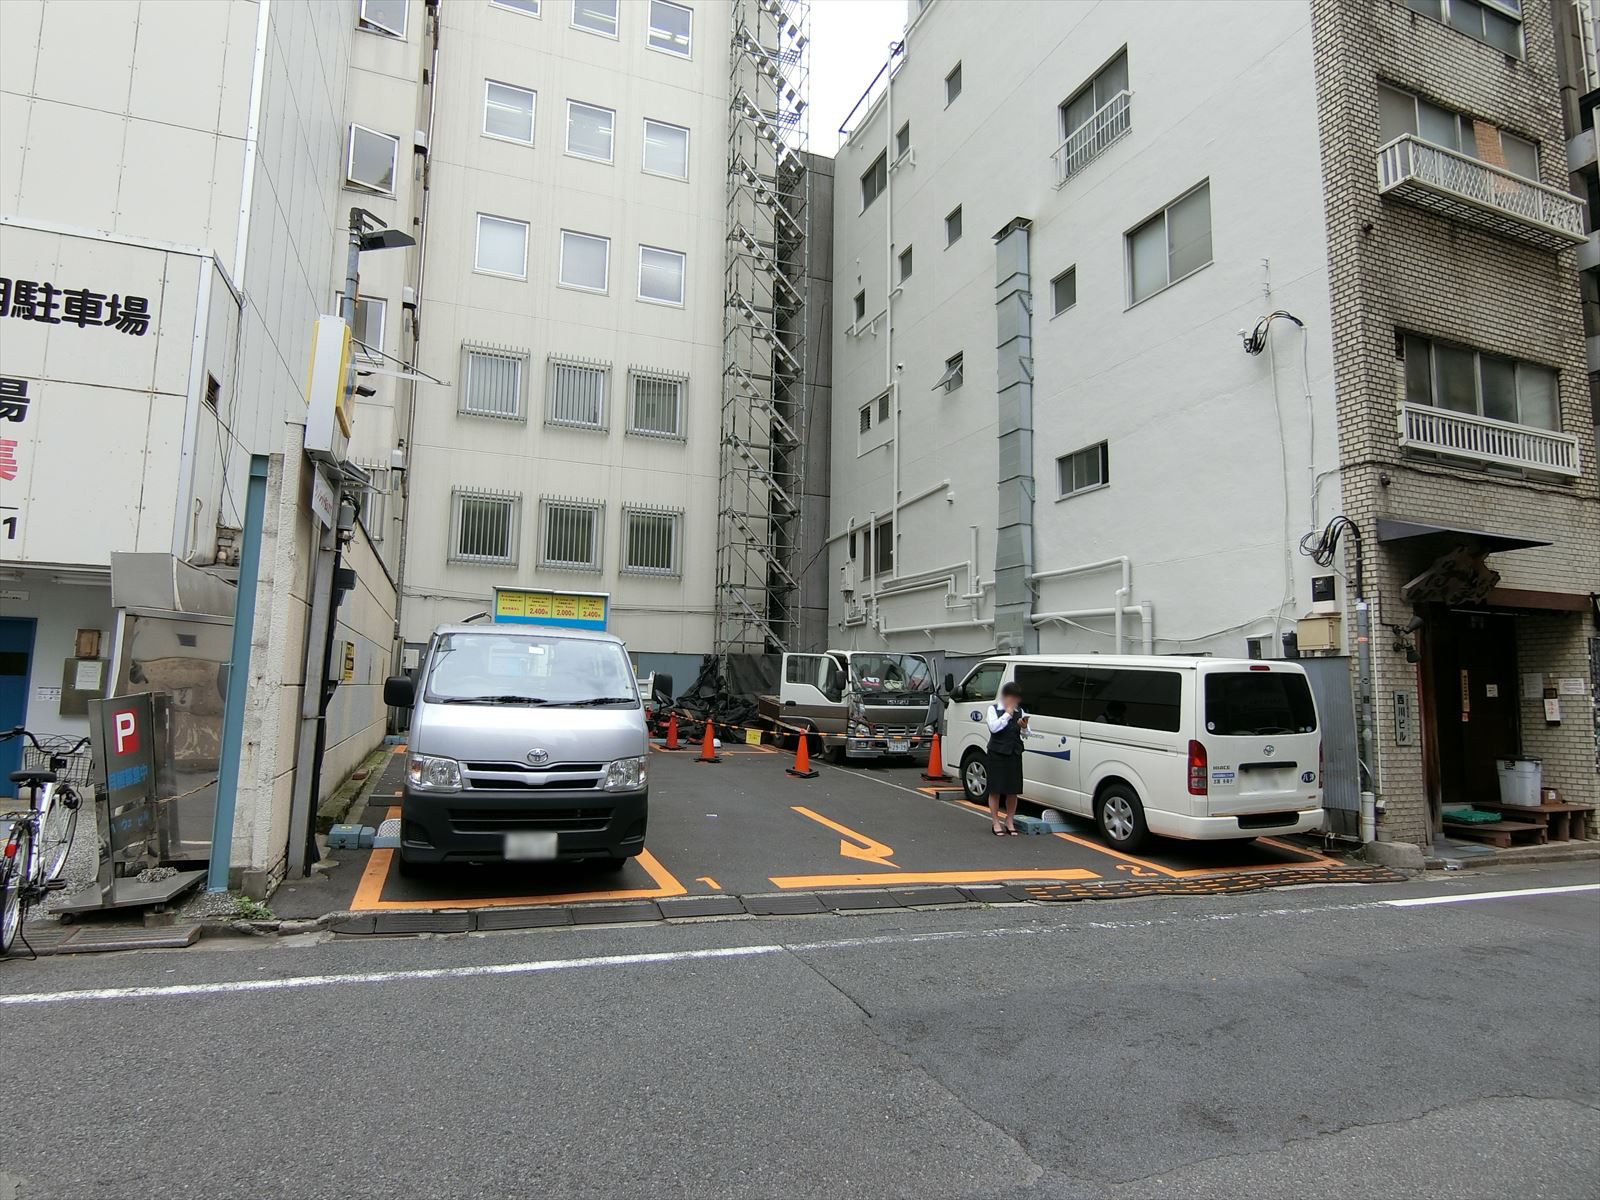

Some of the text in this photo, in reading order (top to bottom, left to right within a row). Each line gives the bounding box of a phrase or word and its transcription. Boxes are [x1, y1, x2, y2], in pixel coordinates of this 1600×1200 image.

[0, 278, 150, 336] 駐車場
[116, 712, 135, 753] P
